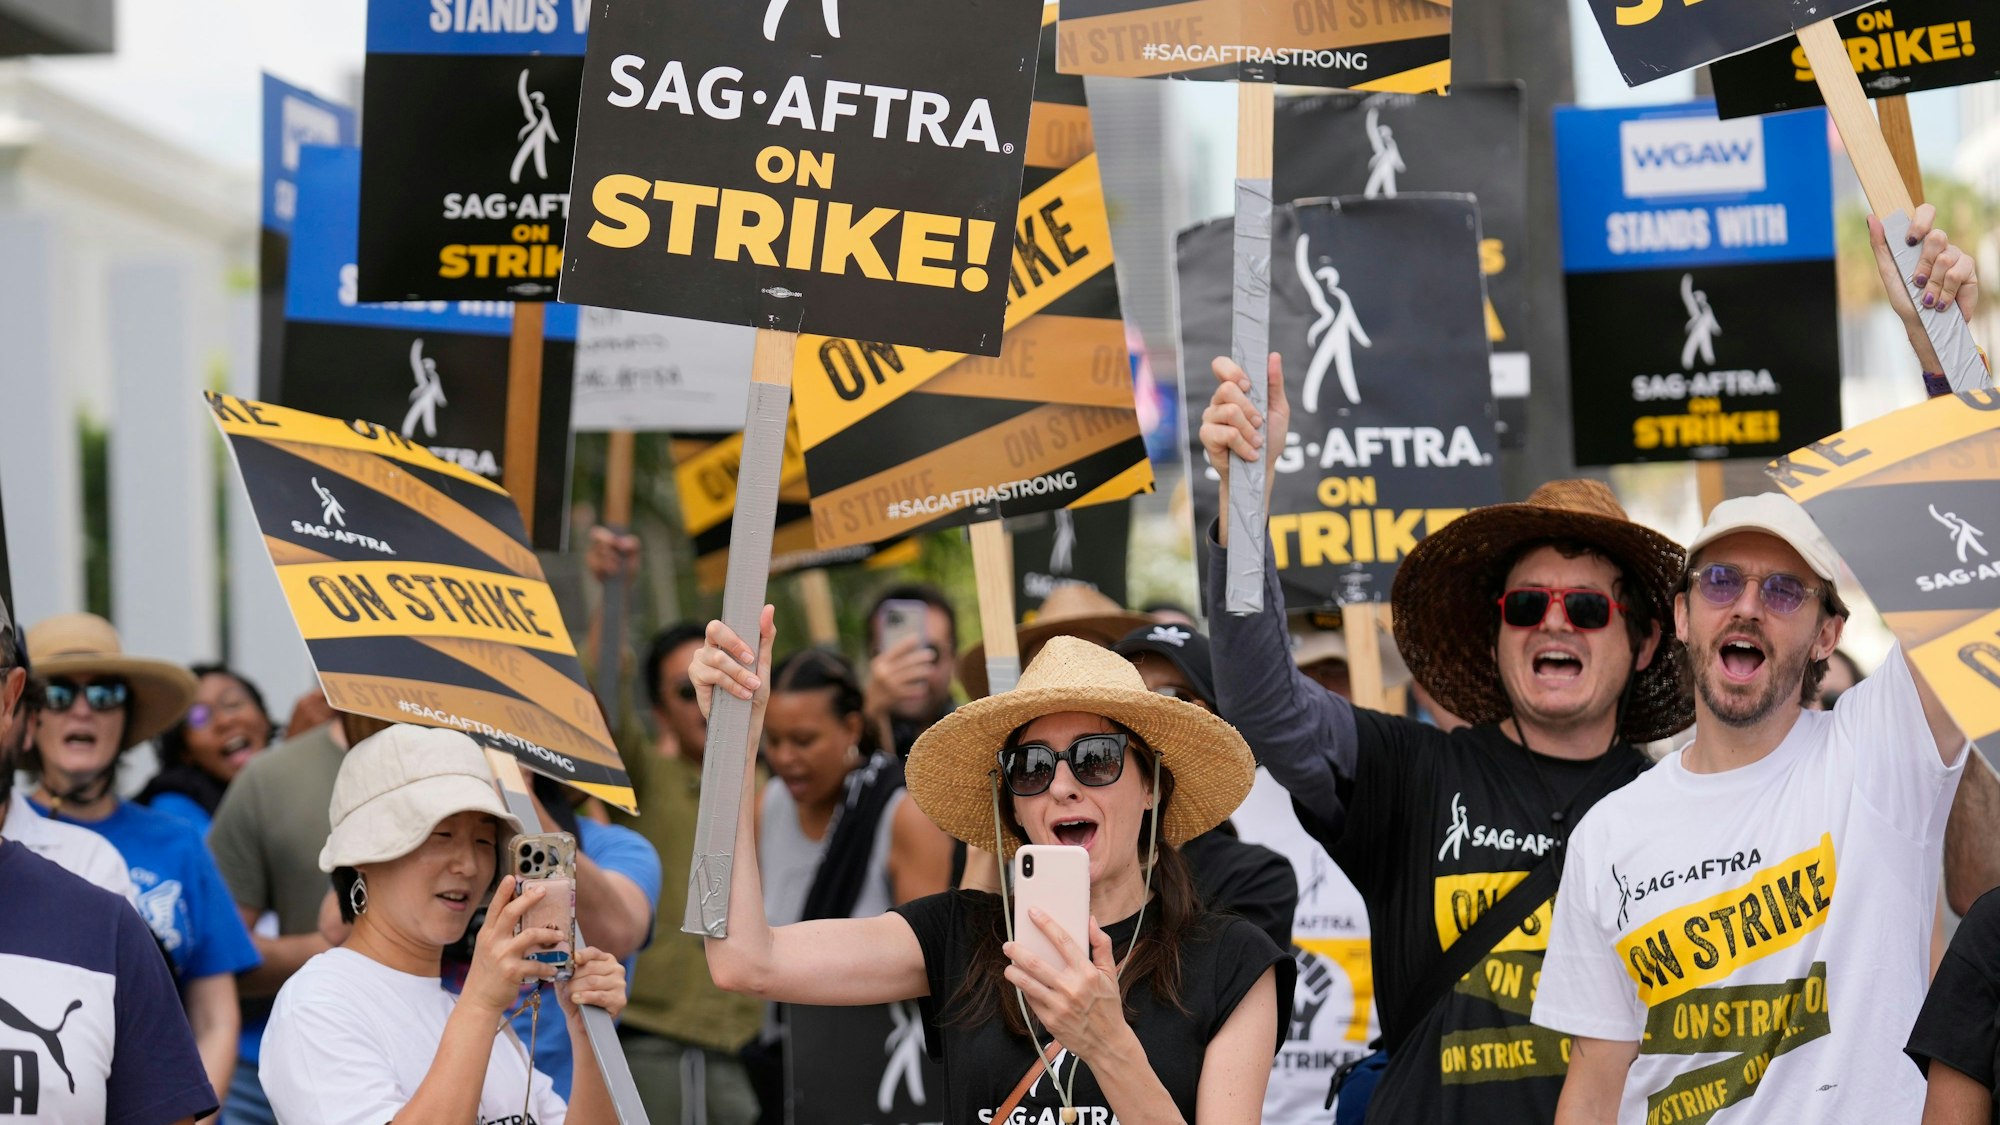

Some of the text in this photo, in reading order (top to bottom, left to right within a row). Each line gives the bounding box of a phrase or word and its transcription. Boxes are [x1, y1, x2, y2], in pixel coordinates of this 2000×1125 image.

[1856, 9, 1895, 33] ON
[1143, 43, 1368, 71] #SAGAFTRASTRONG
[1791, 20, 1976, 82] SRIKE!
[755, 145, 835, 190] ON
[1631, 138, 1754, 170] WGAW
[512, 224, 549, 243] ON
[587, 173, 996, 293] STRIKE!
[1606, 203, 1788, 255] STANDS WITH
[819, 337, 904, 401] ON
[1687, 396, 1722, 414] ON
[1003, 427, 1044, 468] ON
[1633, 410, 1780, 449] STRIKE!
[887, 471, 1078, 520] #SAGAFTRASTRONG
[1317, 476, 1377, 507] ON
[308, 574, 554, 638] ON STRIKE
[398, 699, 576, 773] #SAGAFTRASTRONG
[1629, 859, 1831, 989] ON STRIKE
[1486, 959, 1523, 999] ON
[1673, 1003, 1709, 1040] ON
[1441, 1046, 1466, 1073] ON
[1470, 1040, 1537, 1071] STRIKE
